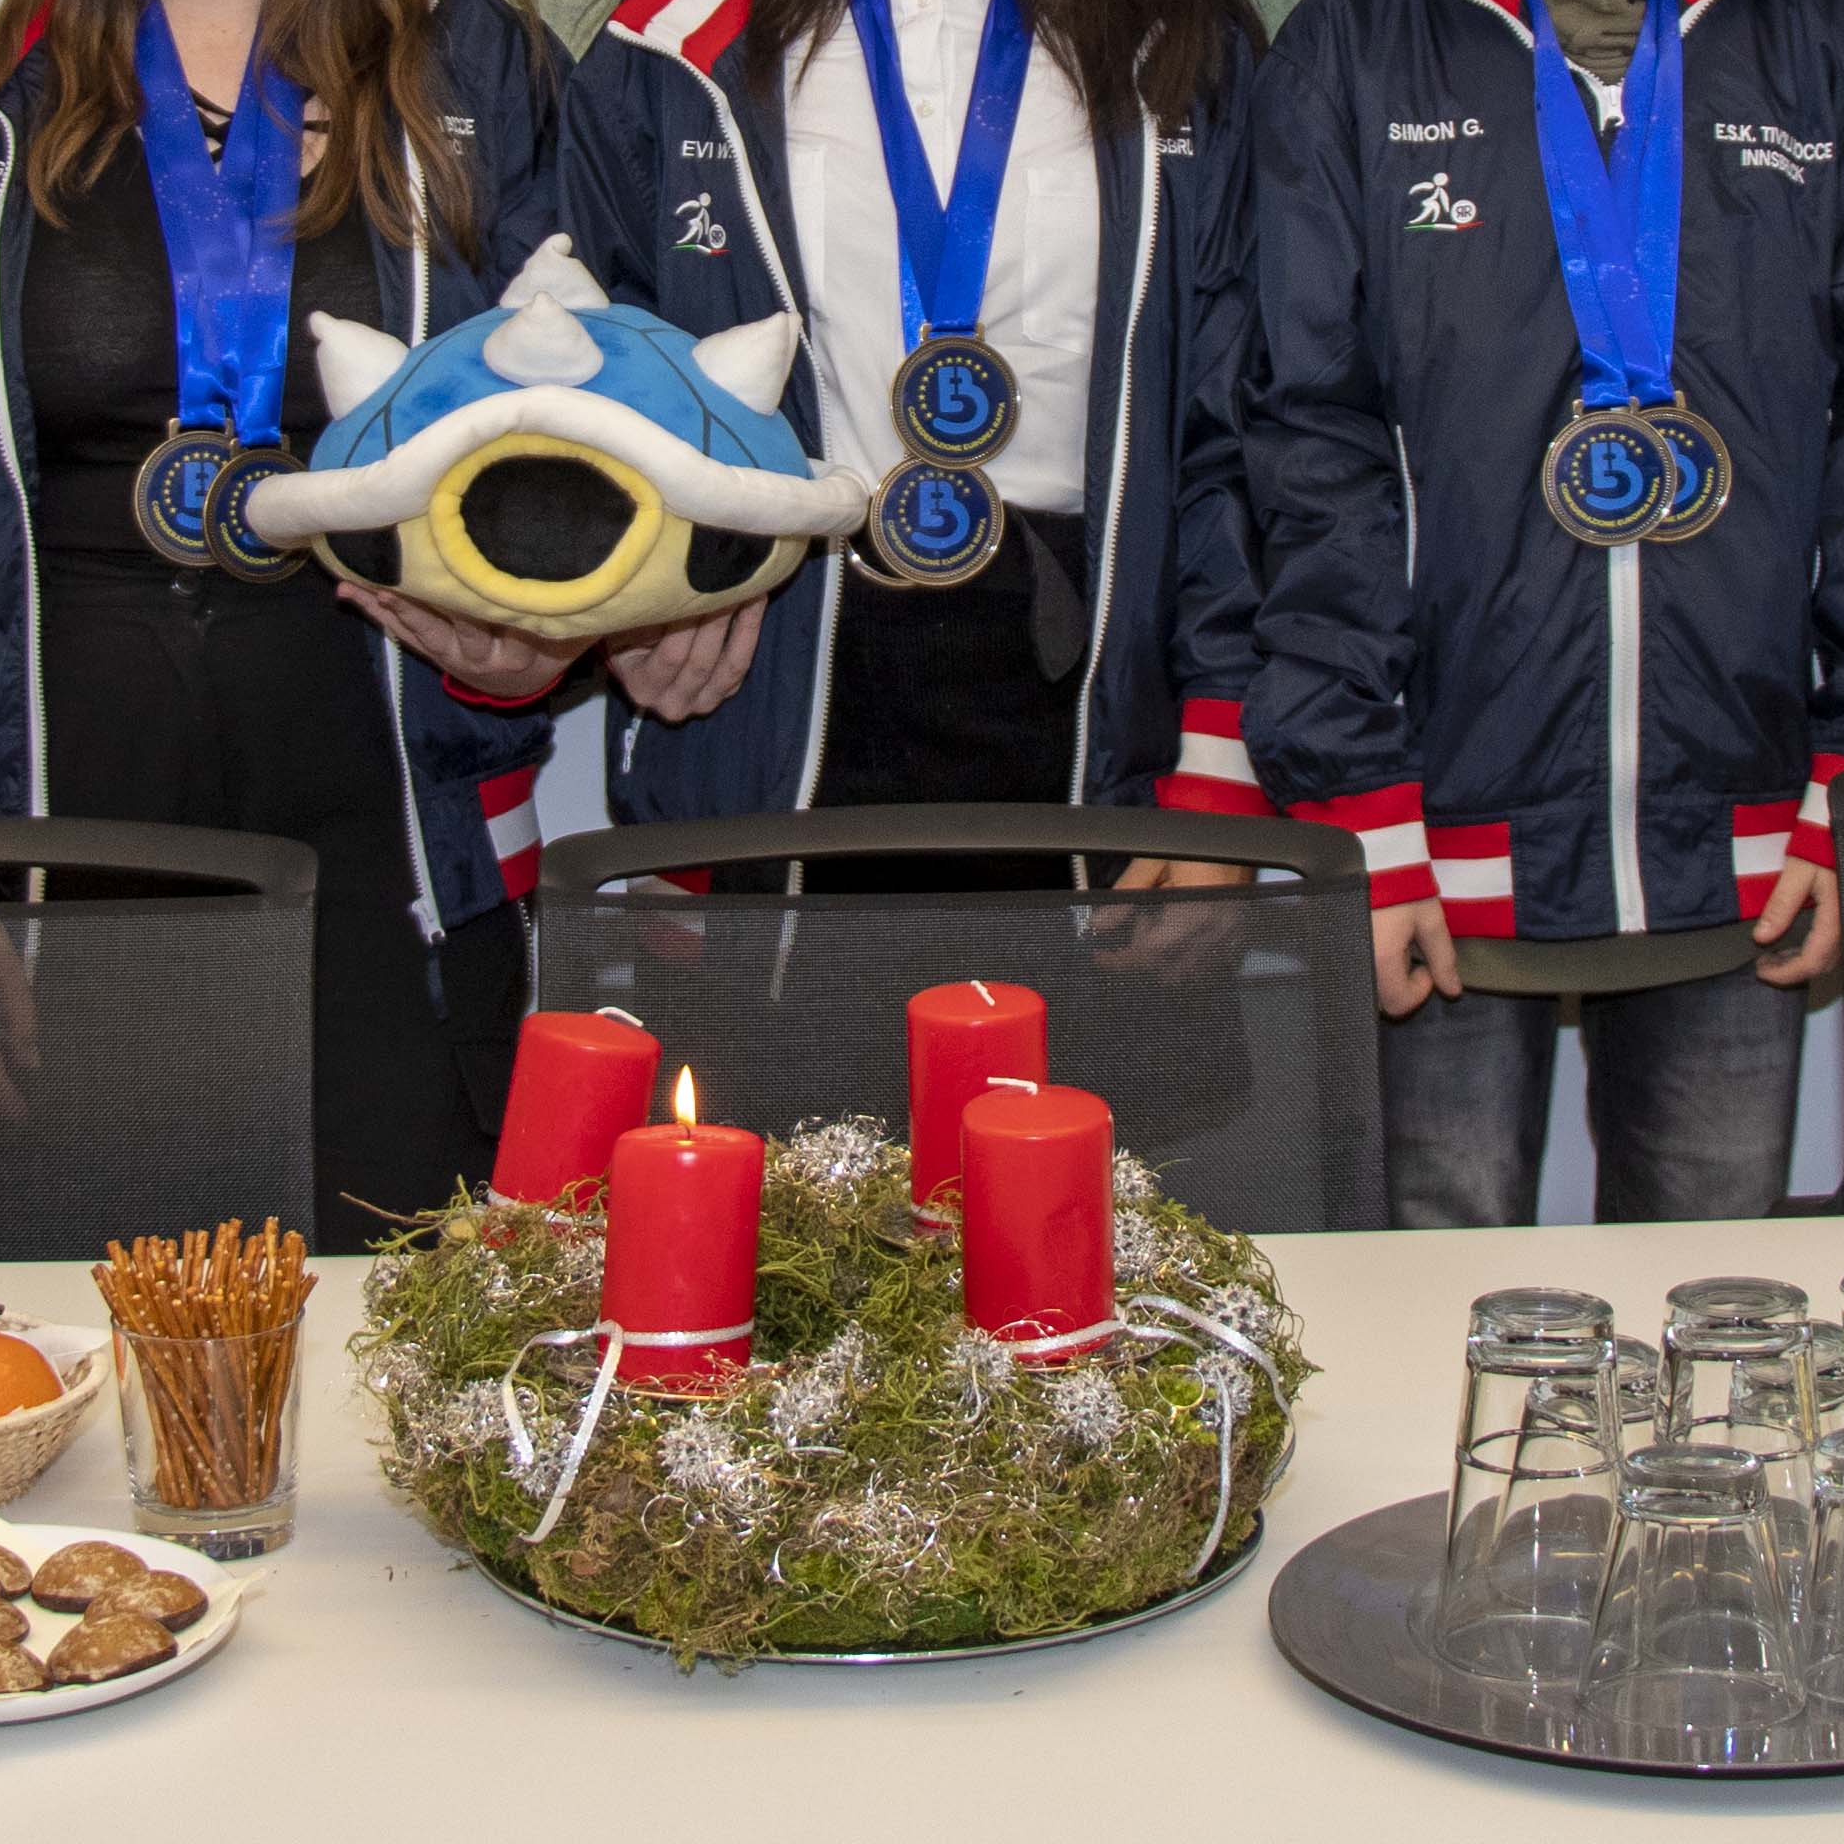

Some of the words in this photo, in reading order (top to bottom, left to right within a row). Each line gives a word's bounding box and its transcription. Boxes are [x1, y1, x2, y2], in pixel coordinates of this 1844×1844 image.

[1388, 120, 1456, 142] SIMON
[1462, 118, 1484, 136] G.
[681, 139, 714, 159] EVI
